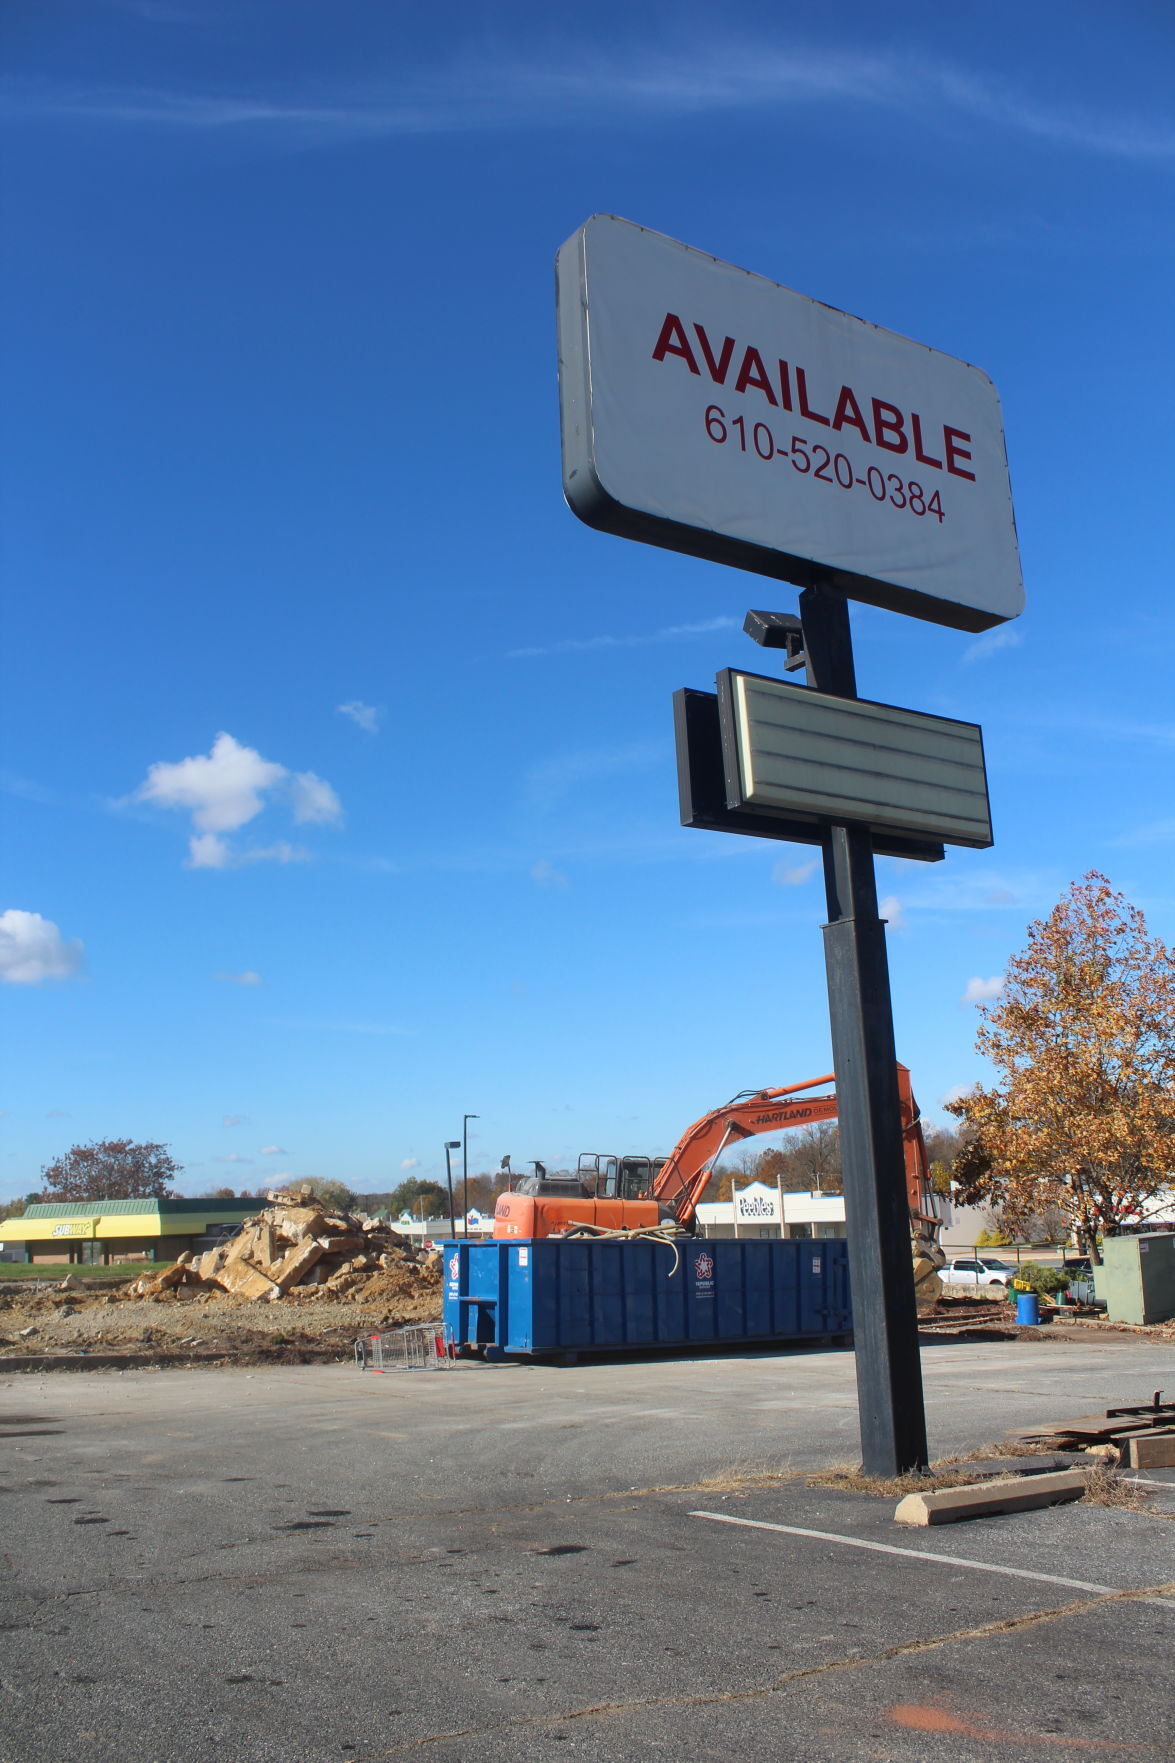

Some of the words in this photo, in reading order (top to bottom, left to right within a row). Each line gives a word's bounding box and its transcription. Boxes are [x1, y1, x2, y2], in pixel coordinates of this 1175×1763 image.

[652, 312, 976, 482] AVAILABLE
[704, 404, 946, 524] 610-520-0384
[755, 1107, 812, 1125] HARTLAND
[739, 1197, 774, 1216] Peebles
[52, 1222, 90, 1237] SUBWAY
